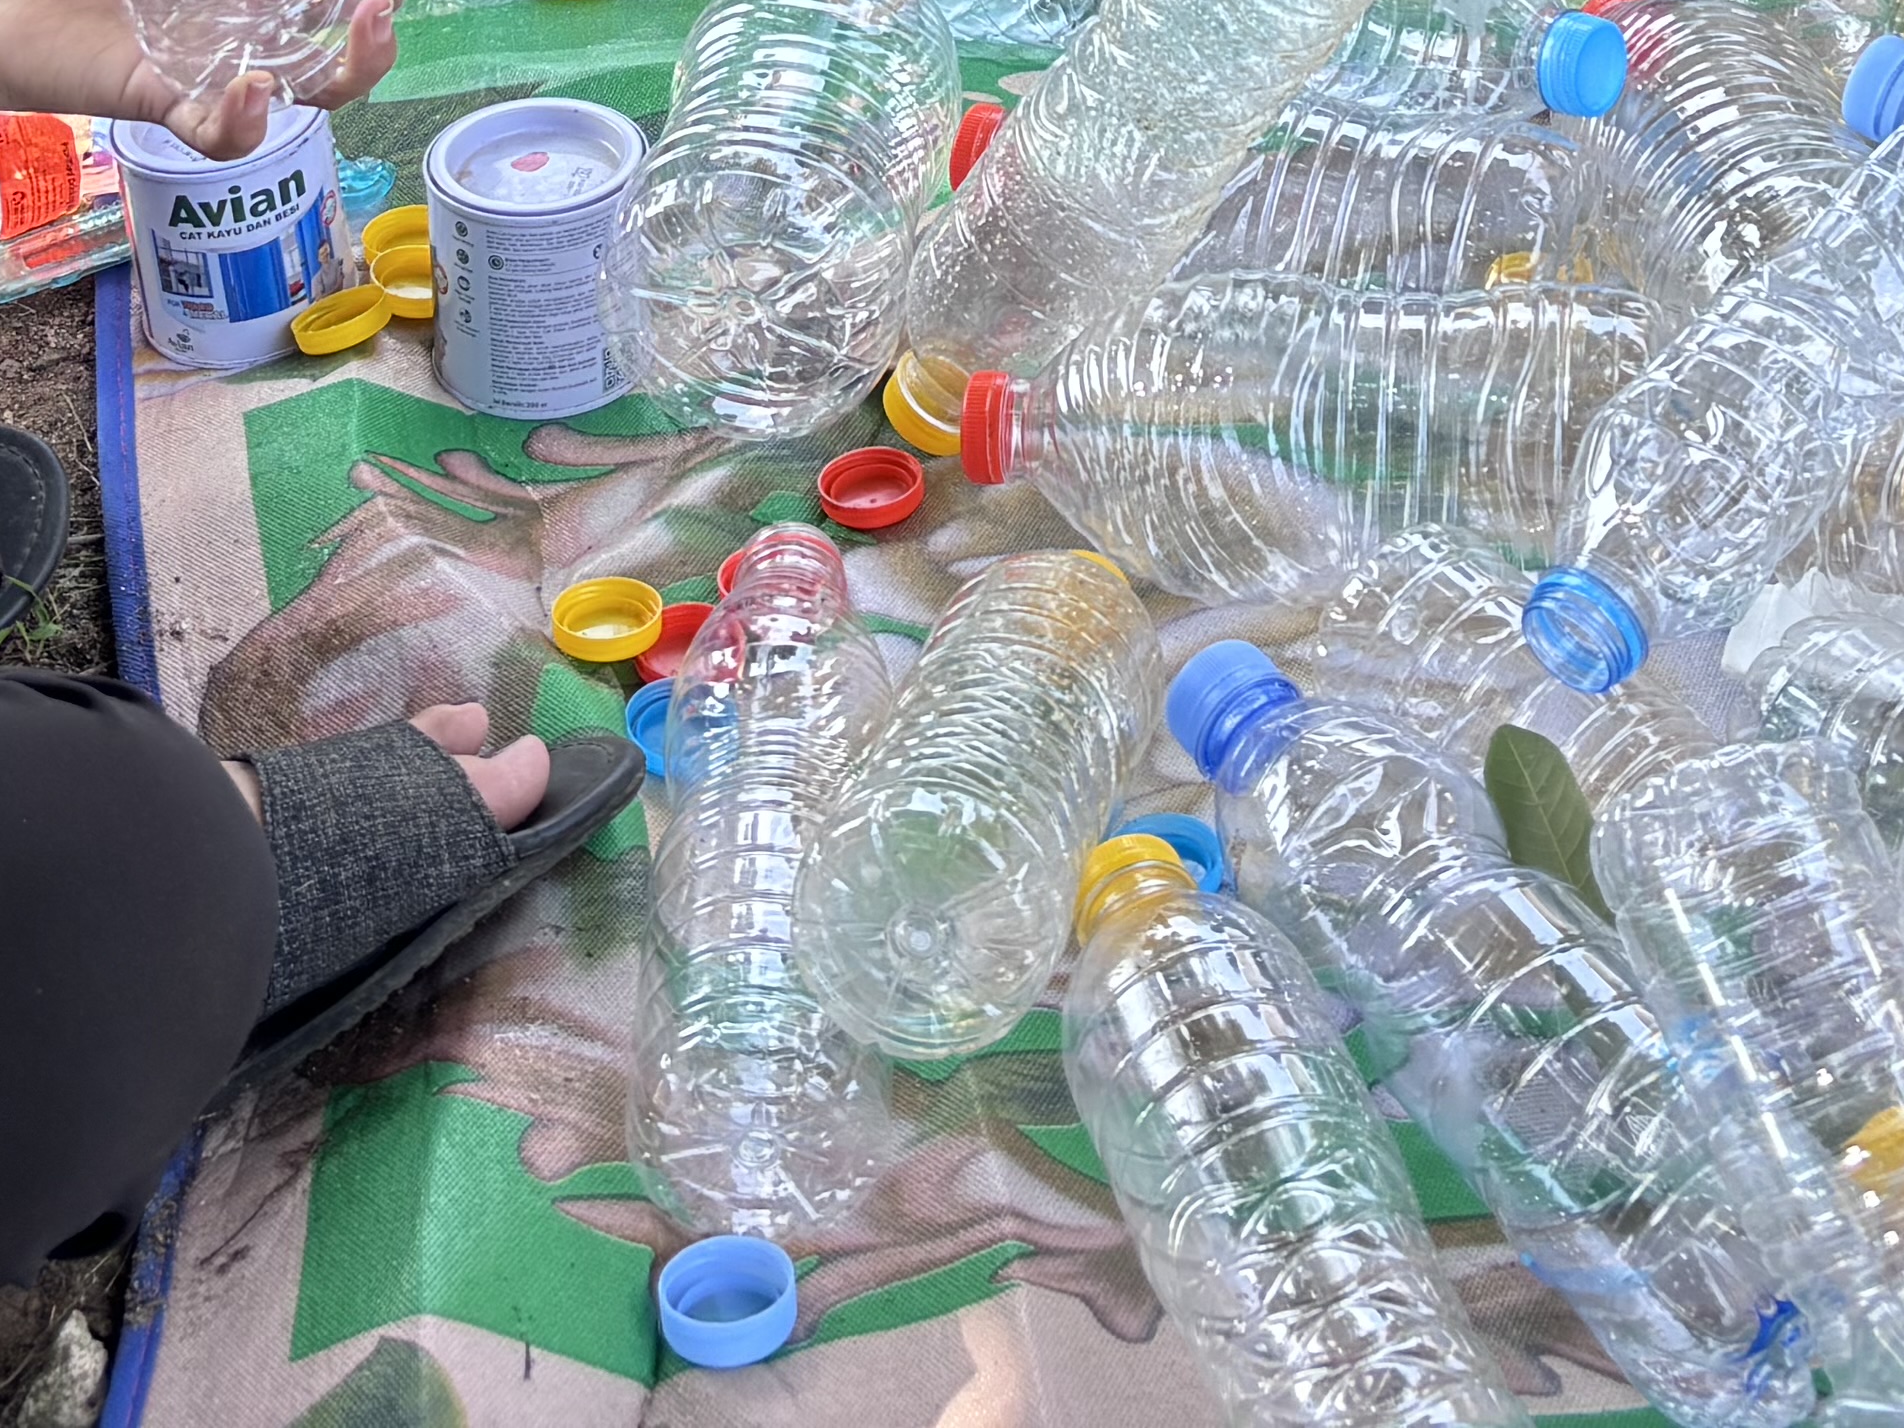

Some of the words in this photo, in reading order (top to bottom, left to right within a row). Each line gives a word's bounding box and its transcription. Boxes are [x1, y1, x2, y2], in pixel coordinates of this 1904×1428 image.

[168, 169, 306, 228] Avian
[179, 230, 203, 241] CAT
[207, 226, 243, 240] KAYU
[246, 218, 272, 233] DAN
[275, 203, 301, 222] BESI
